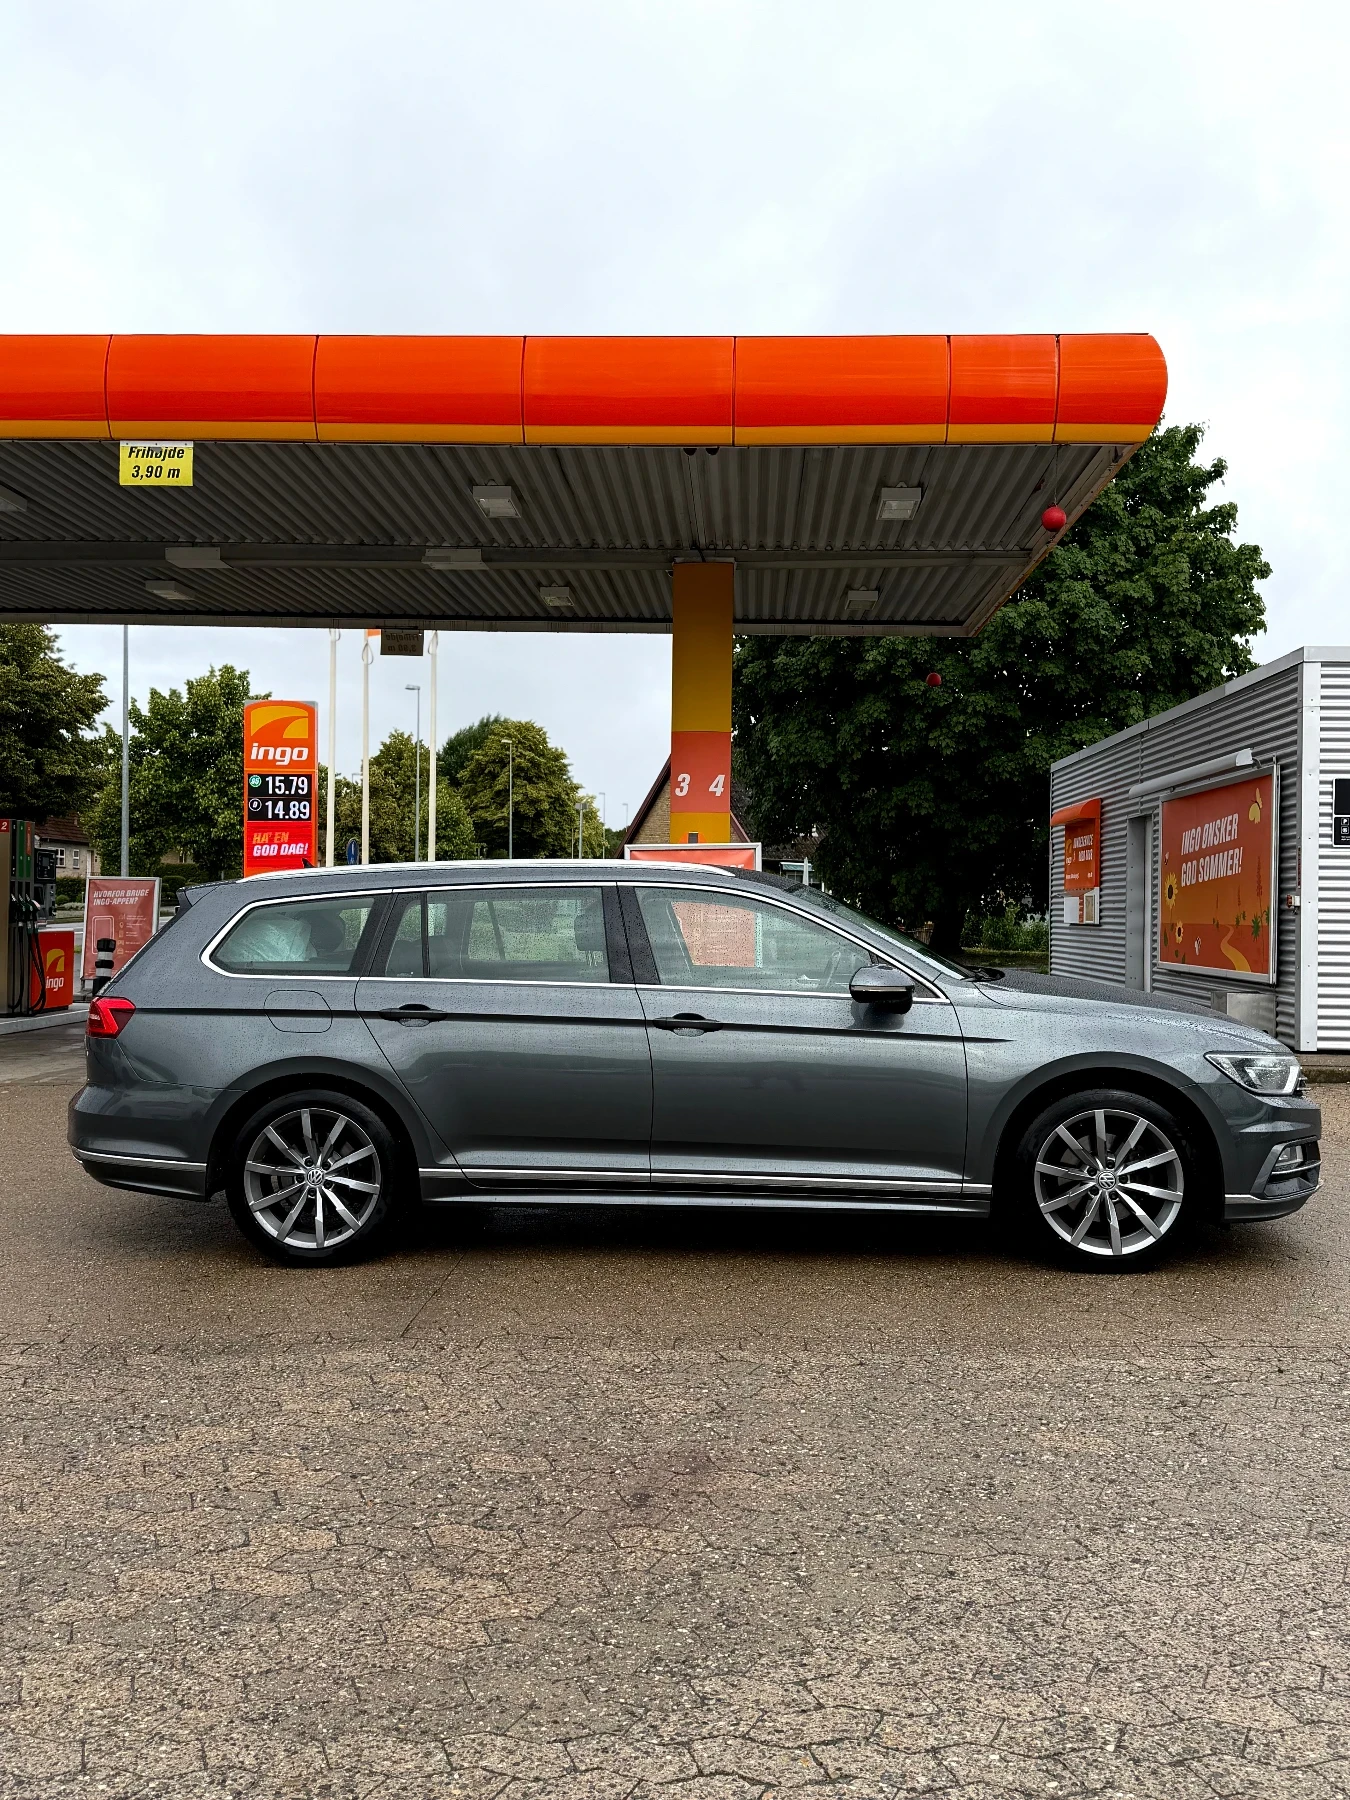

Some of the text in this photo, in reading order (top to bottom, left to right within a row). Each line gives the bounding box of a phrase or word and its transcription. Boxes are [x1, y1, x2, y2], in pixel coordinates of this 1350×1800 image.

[131, 465, 181, 480] 3,90 m
[250, 742, 309, 766] ingo
[265, 776, 308, 795] 15.79
[674, 773, 691, 797] 3
[708, 774, 726, 797] 4
[264, 800, 310, 819] 14.89
[0, 821, 8, 830] 2
[1181, 813, 1239, 856] INGO ØNSKER
[273, 831, 289, 844] EN
[252, 842, 309, 857] GOD DAG!
[1181, 847, 1243, 887] GOD SOMMER!
[93, 888, 150, 898] HVORFOR BRUGE
[45, 975, 65, 991] ingo
